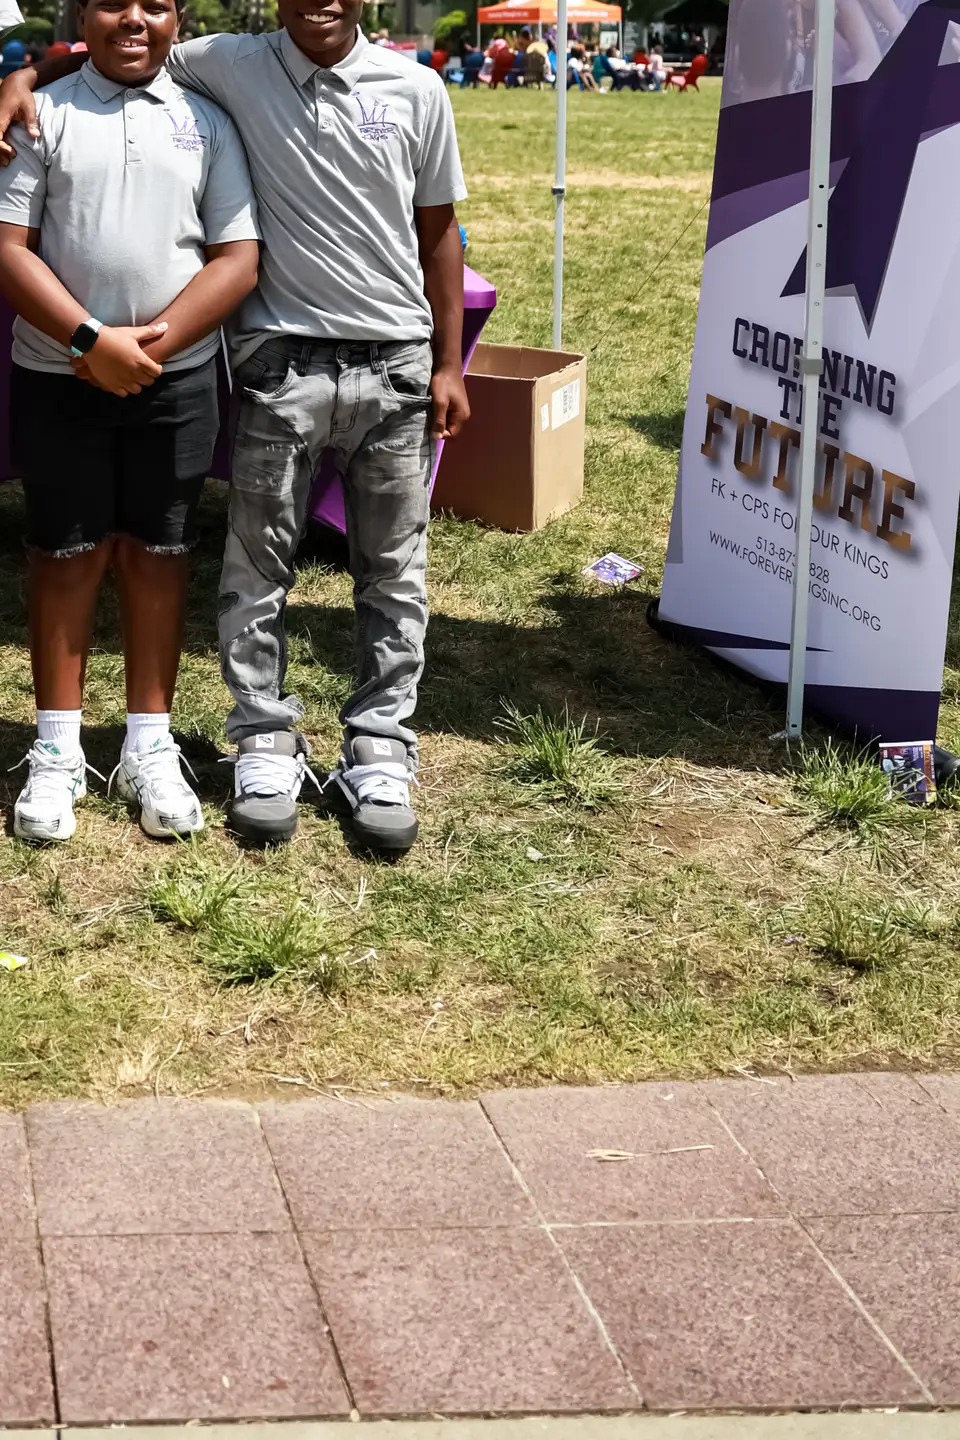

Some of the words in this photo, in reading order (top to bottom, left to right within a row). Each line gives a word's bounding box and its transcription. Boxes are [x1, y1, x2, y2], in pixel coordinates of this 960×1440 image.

[711, 478, 726, 500] FK
[742, 493, 770, 520] CPS
[843, 541, 889, 580] KINGS
